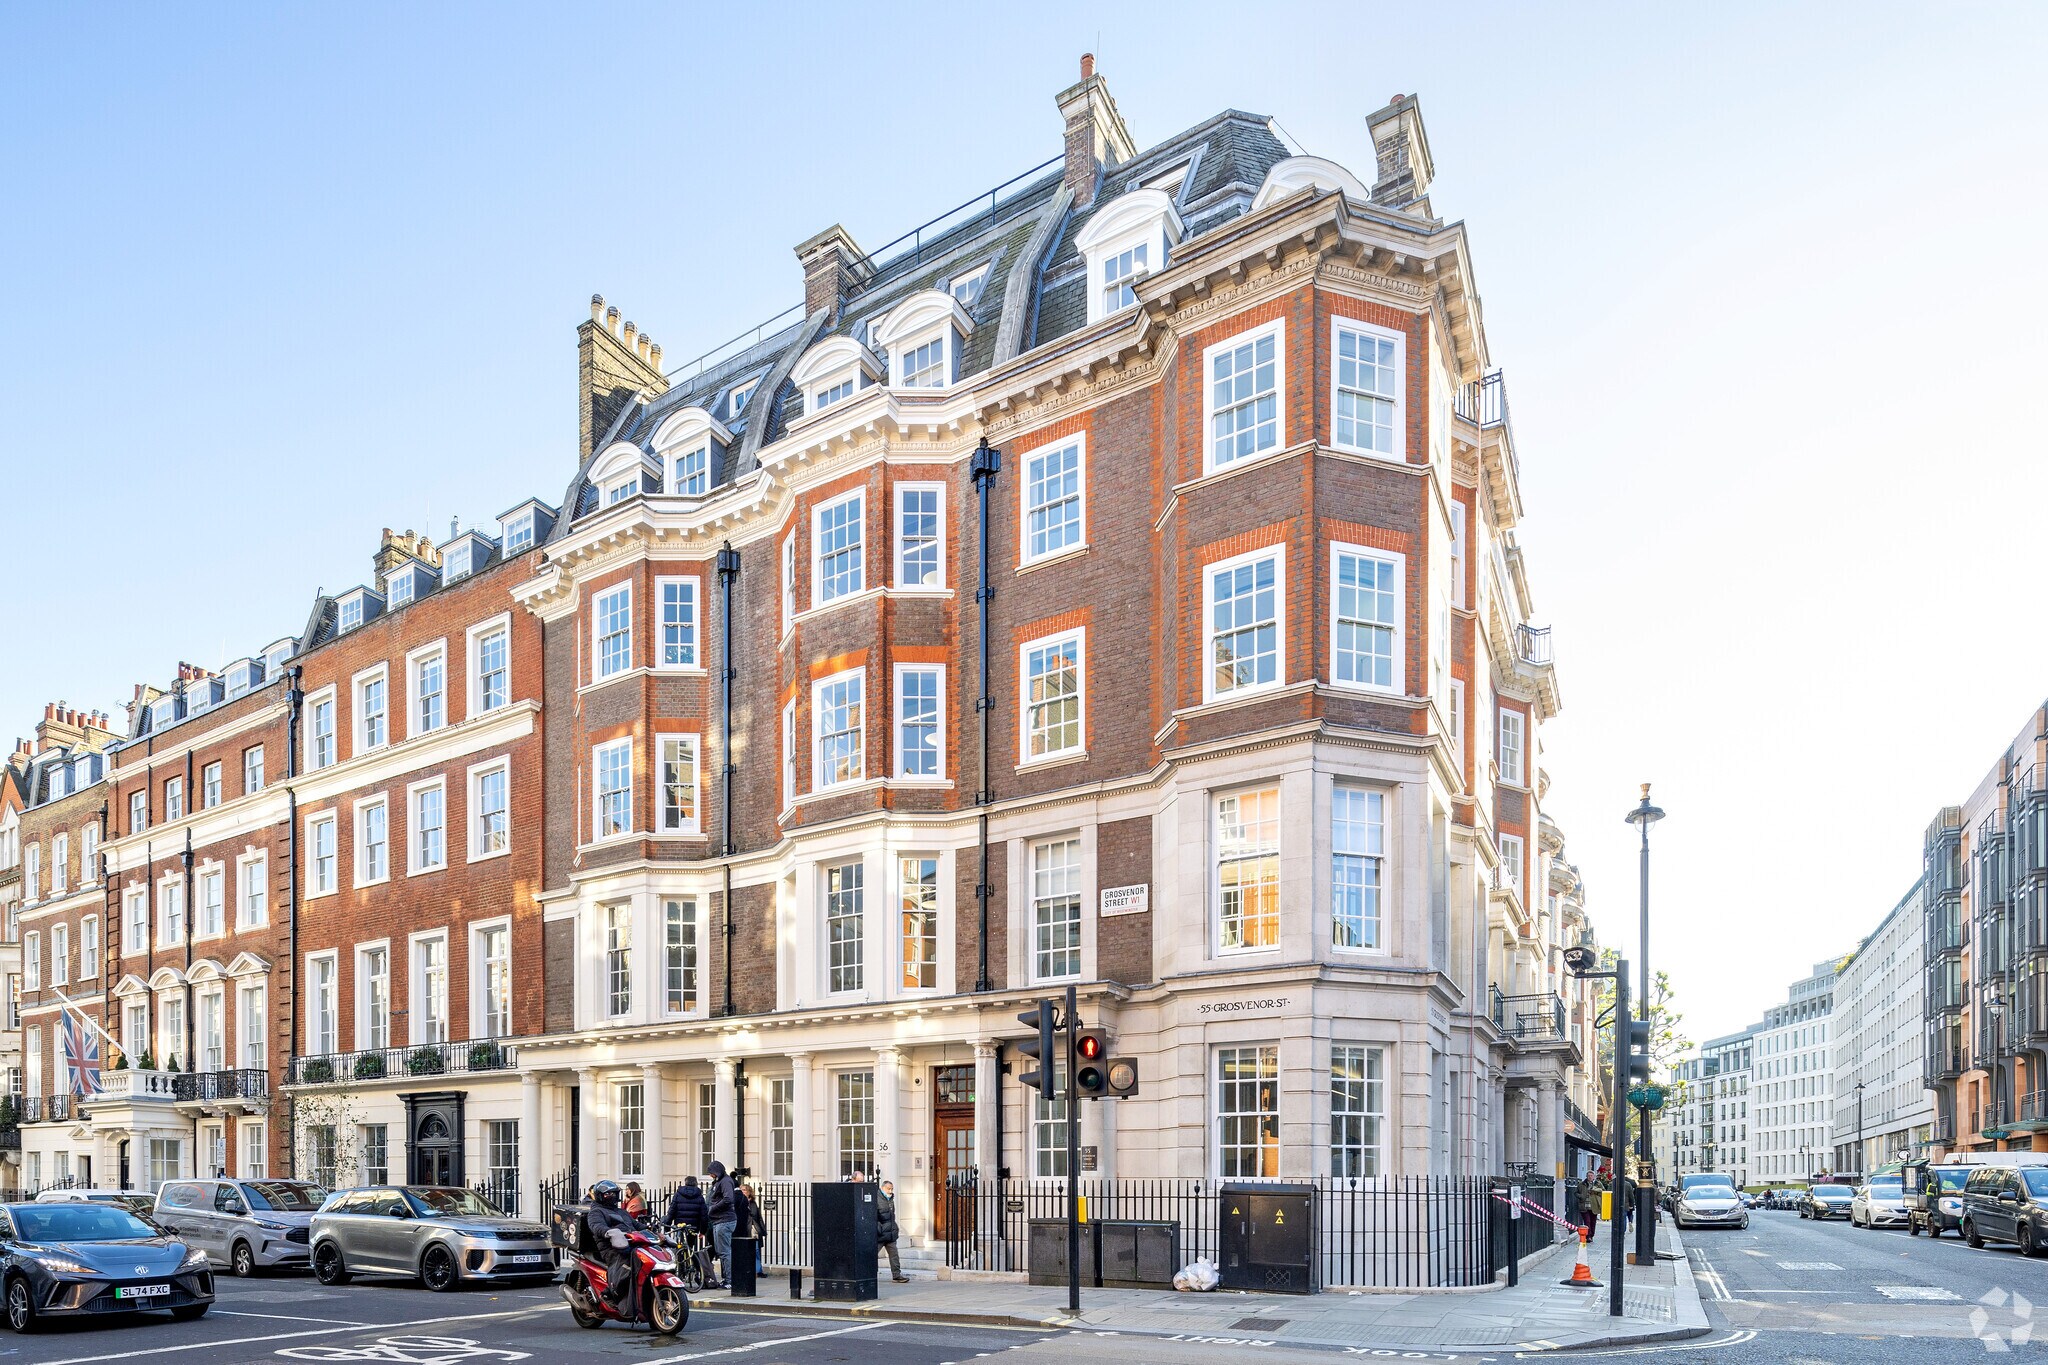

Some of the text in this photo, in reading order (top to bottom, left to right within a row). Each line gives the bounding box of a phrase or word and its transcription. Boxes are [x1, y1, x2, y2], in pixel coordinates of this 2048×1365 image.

[1104, 887, 1145, 899] GROSVENOR
[1104, 896, 1140, 908] STREET W1
[879, 1142, 889, 1151] 56
[149, 1285, 168, 1295] FXC
[1157, 1334, 1458, 1360] LOOK RIGHT
